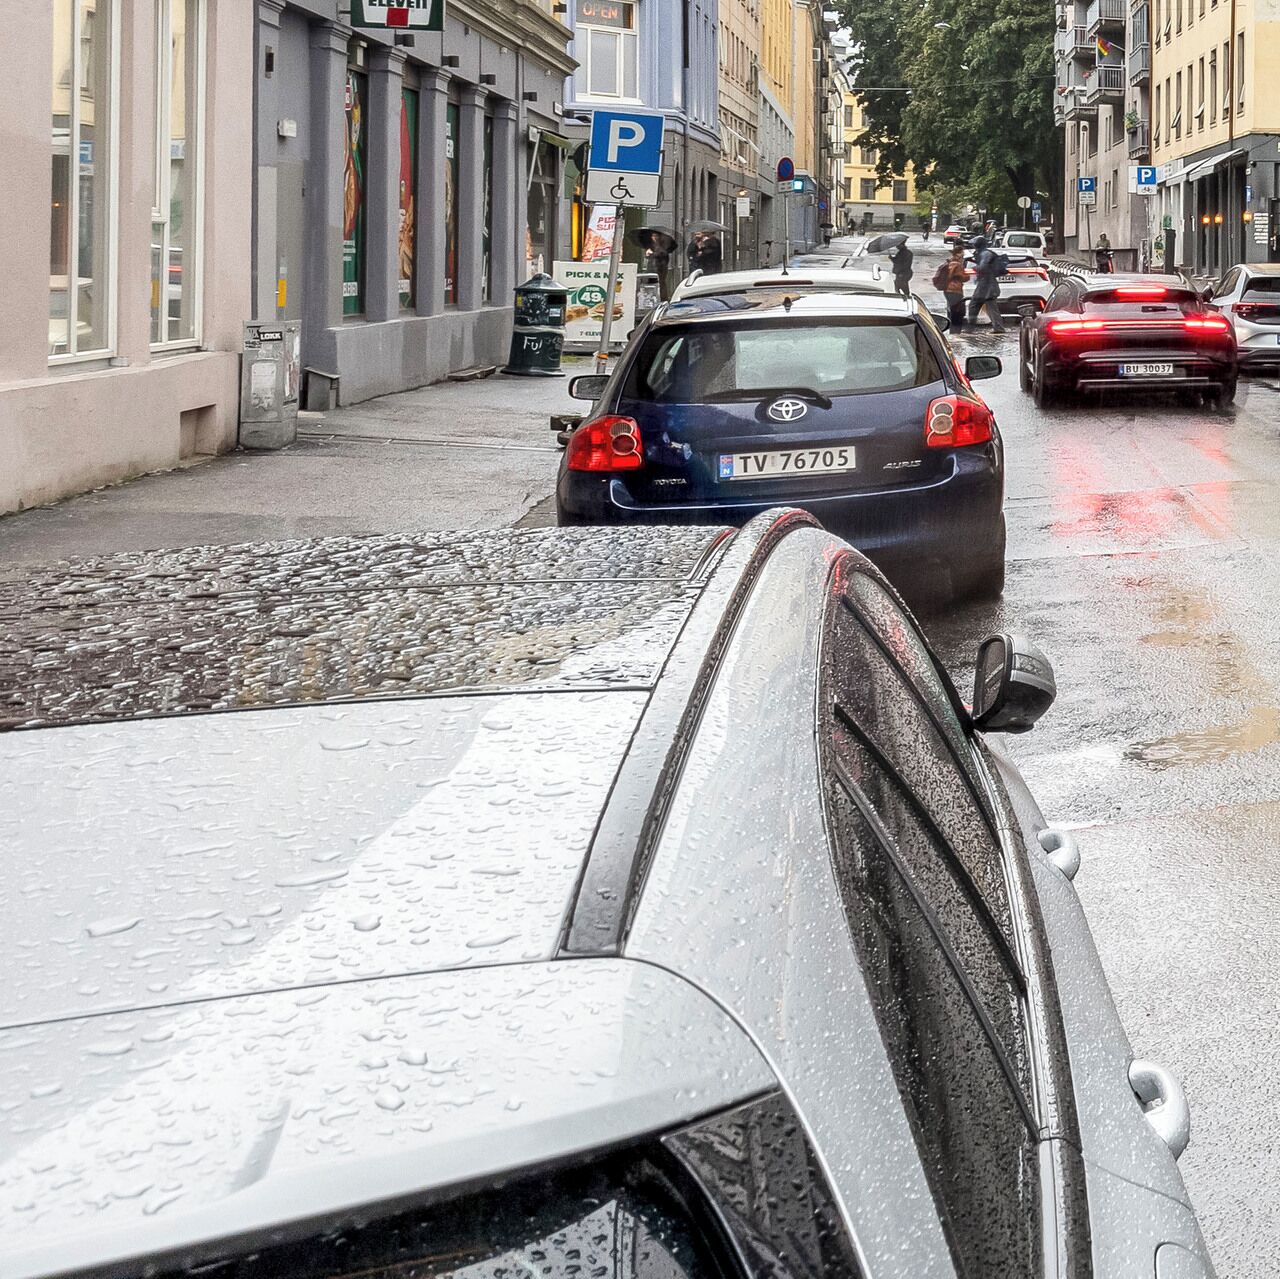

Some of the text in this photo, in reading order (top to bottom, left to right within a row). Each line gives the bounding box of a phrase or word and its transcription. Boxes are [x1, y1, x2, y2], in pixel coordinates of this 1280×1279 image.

[582, 1, 618, 19] OPEN
[607, 120, 646, 163] P
[1141, 169, 1153, 183] P
[1082, 179, 1091, 191] P
[565, 271, 592, 279] PICK
[1125, 364, 1172, 373] BU 30037
[739, 449, 849, 473] TV 76705
[882, 459, 922, 470] AURIS
[654, 478, 688, 486] TOYOTA
